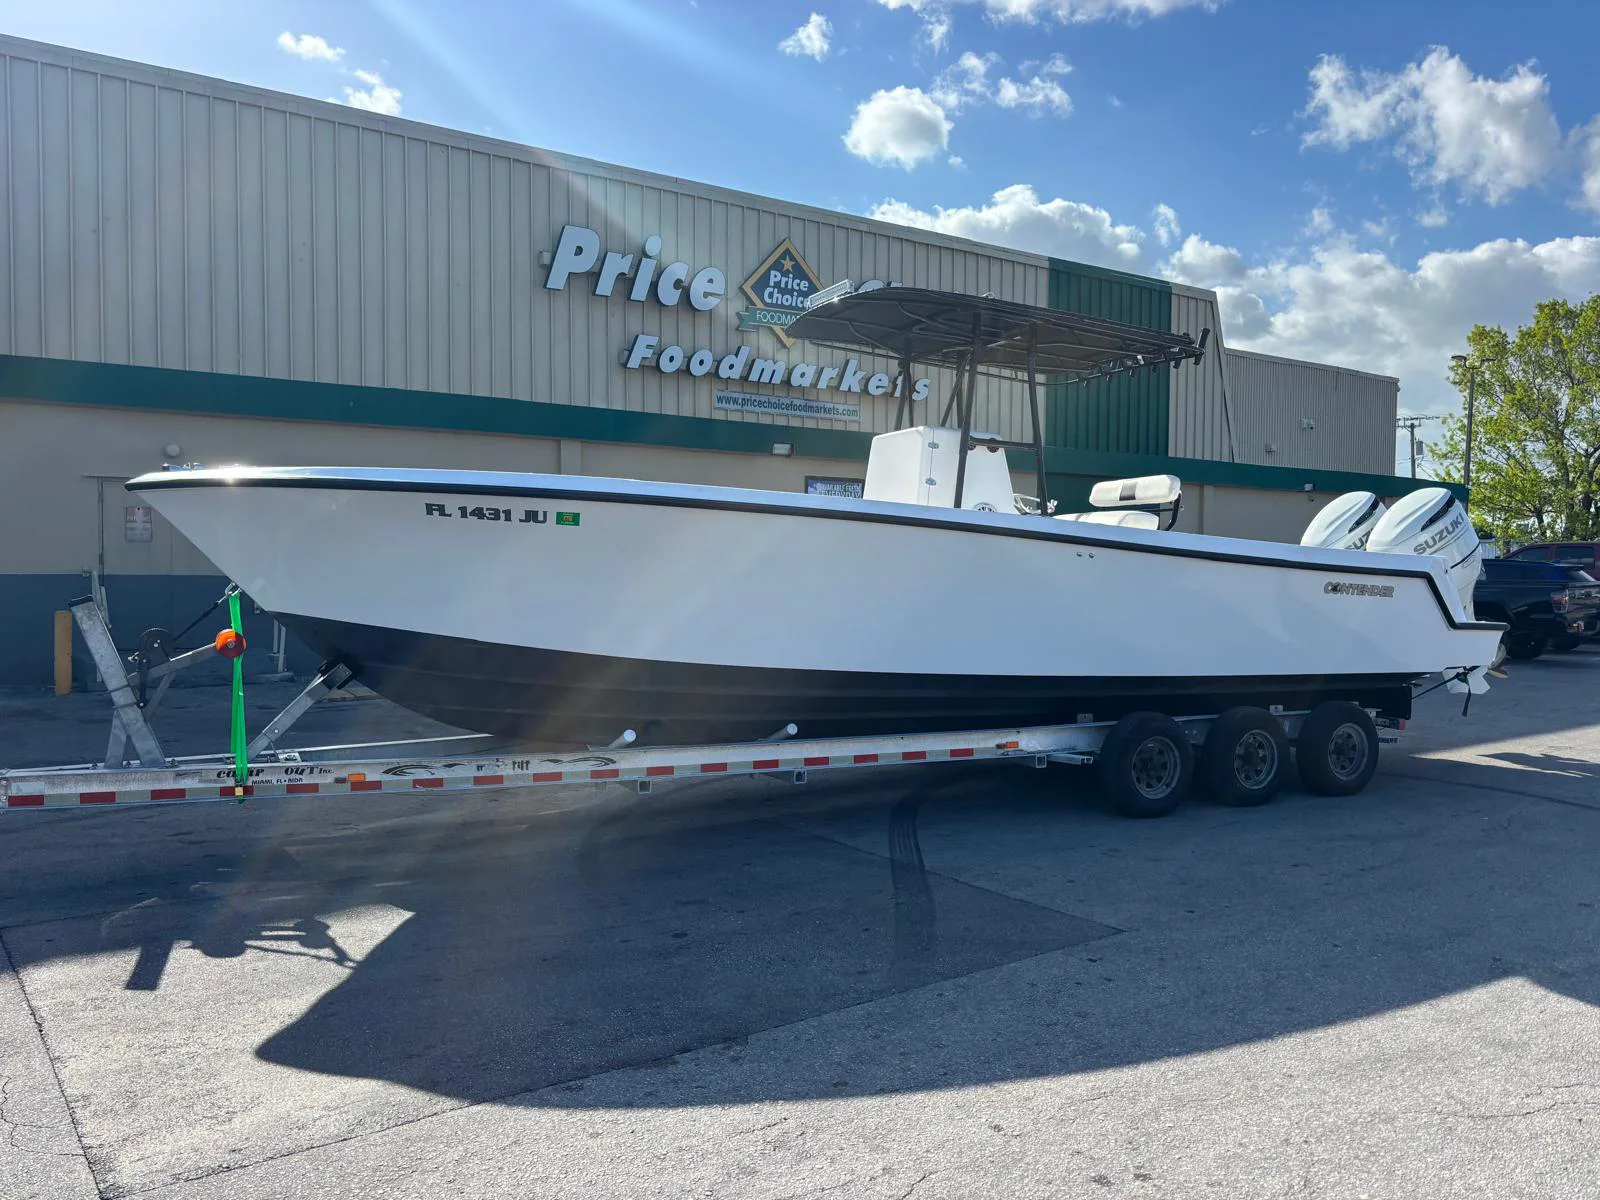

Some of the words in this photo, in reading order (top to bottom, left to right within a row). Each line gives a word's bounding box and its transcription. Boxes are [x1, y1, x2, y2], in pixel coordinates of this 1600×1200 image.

[546, 225, 726, 311] Price
[769, 270, 809, 291] Price
[756, 310, 799, 325] FOODMA
[716, 393, 858, 417] www.pricechoicefoodmarkets.com
[424, 503, 452, 517] FL
[458, 506, 512, 522] 1431
[518, 510, 548, 523] JU
[1413, 512, 1464, 555] SUZUKI
[1324, 581, 1394, 598] CONTENDER
